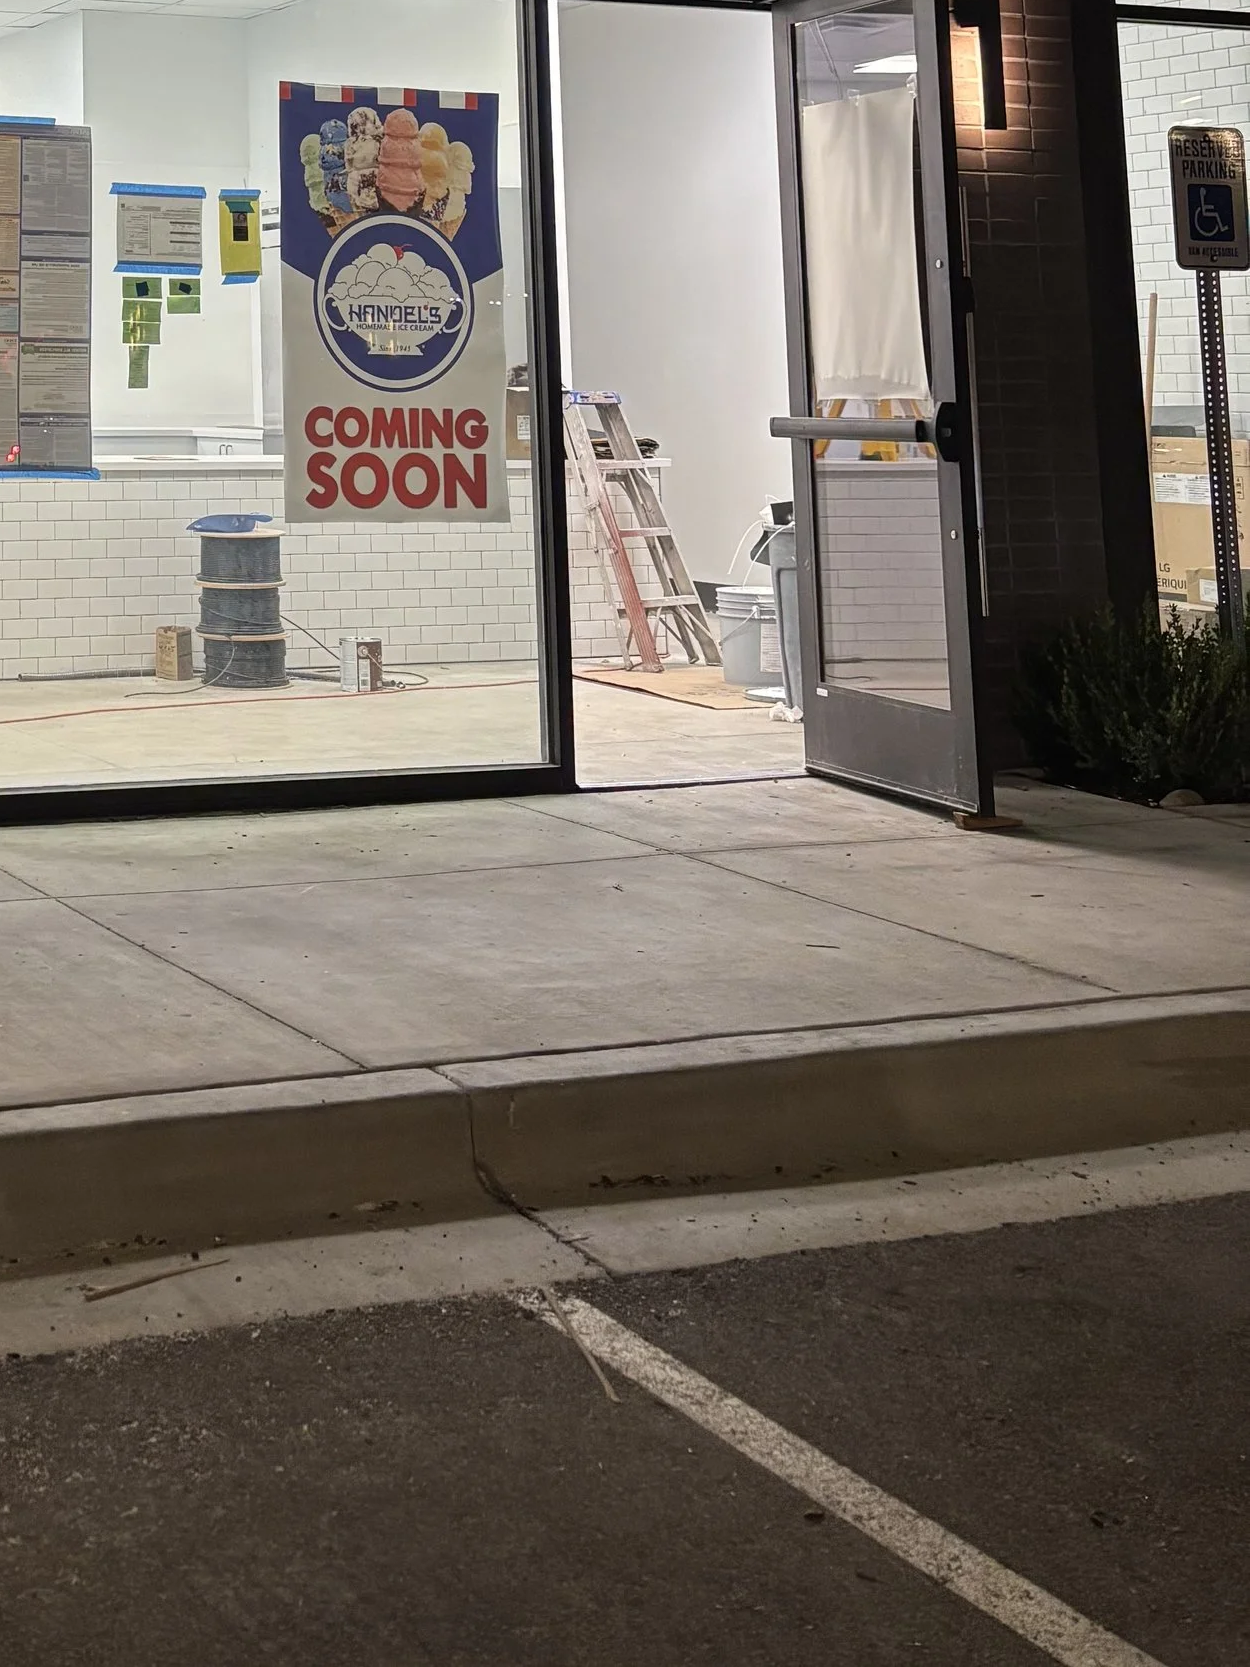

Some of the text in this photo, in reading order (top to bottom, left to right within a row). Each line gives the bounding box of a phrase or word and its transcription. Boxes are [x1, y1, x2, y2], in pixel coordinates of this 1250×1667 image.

[1182, 159, 1236, 179] PARKING
[409, 324, 435, 332] CREAM
[304, 405, 489, 450] COMING
[305, 451, 488, 510] SOON
[1158, 562, 1170, 573] LG
